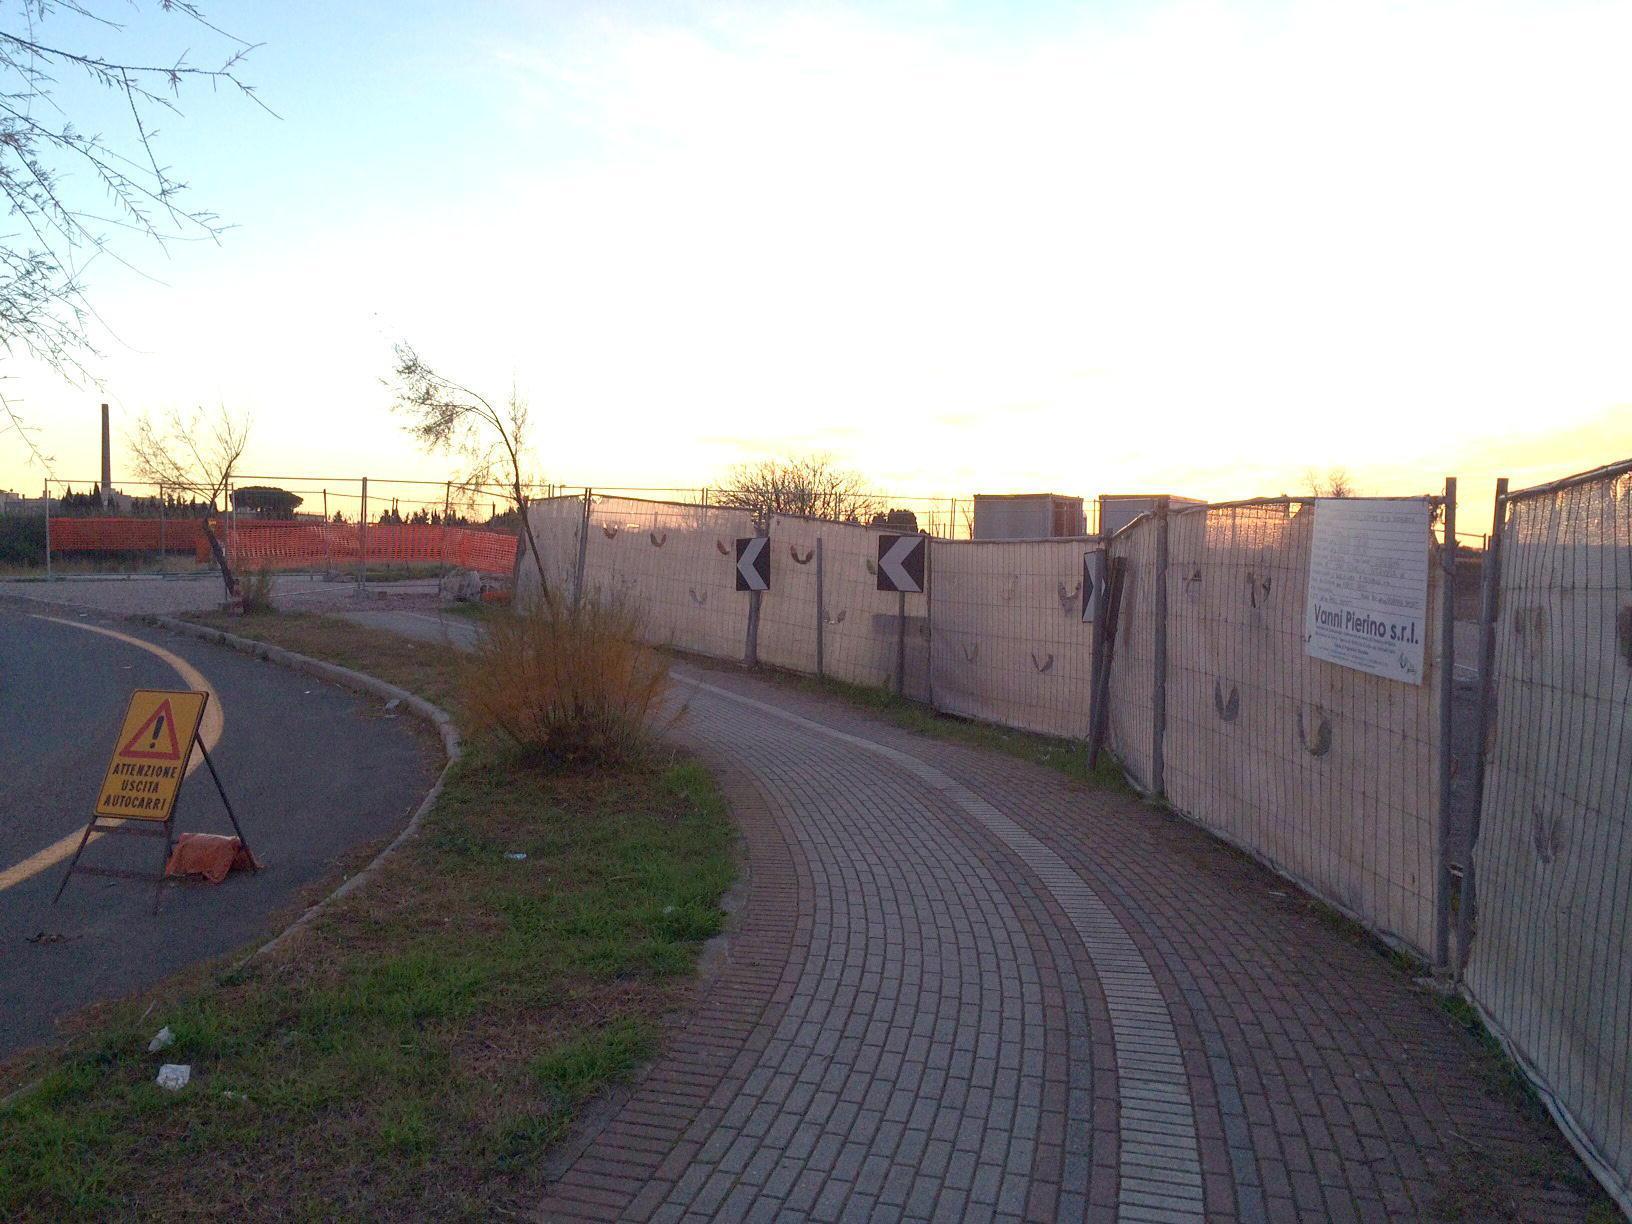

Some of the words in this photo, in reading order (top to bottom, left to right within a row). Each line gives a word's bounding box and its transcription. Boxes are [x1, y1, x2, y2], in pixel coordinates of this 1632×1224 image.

[1314, 603, 1343, 629] Vanni
[1345, 610, 1387, 638] Pierino
[1390, 622, 1419, 645] s.r.l.
[112, 763, 178, 779] ATTENZIONE
[121, 780, 160, 794] USCITA
[103, 794, 167, 811] AUTOCARRI
